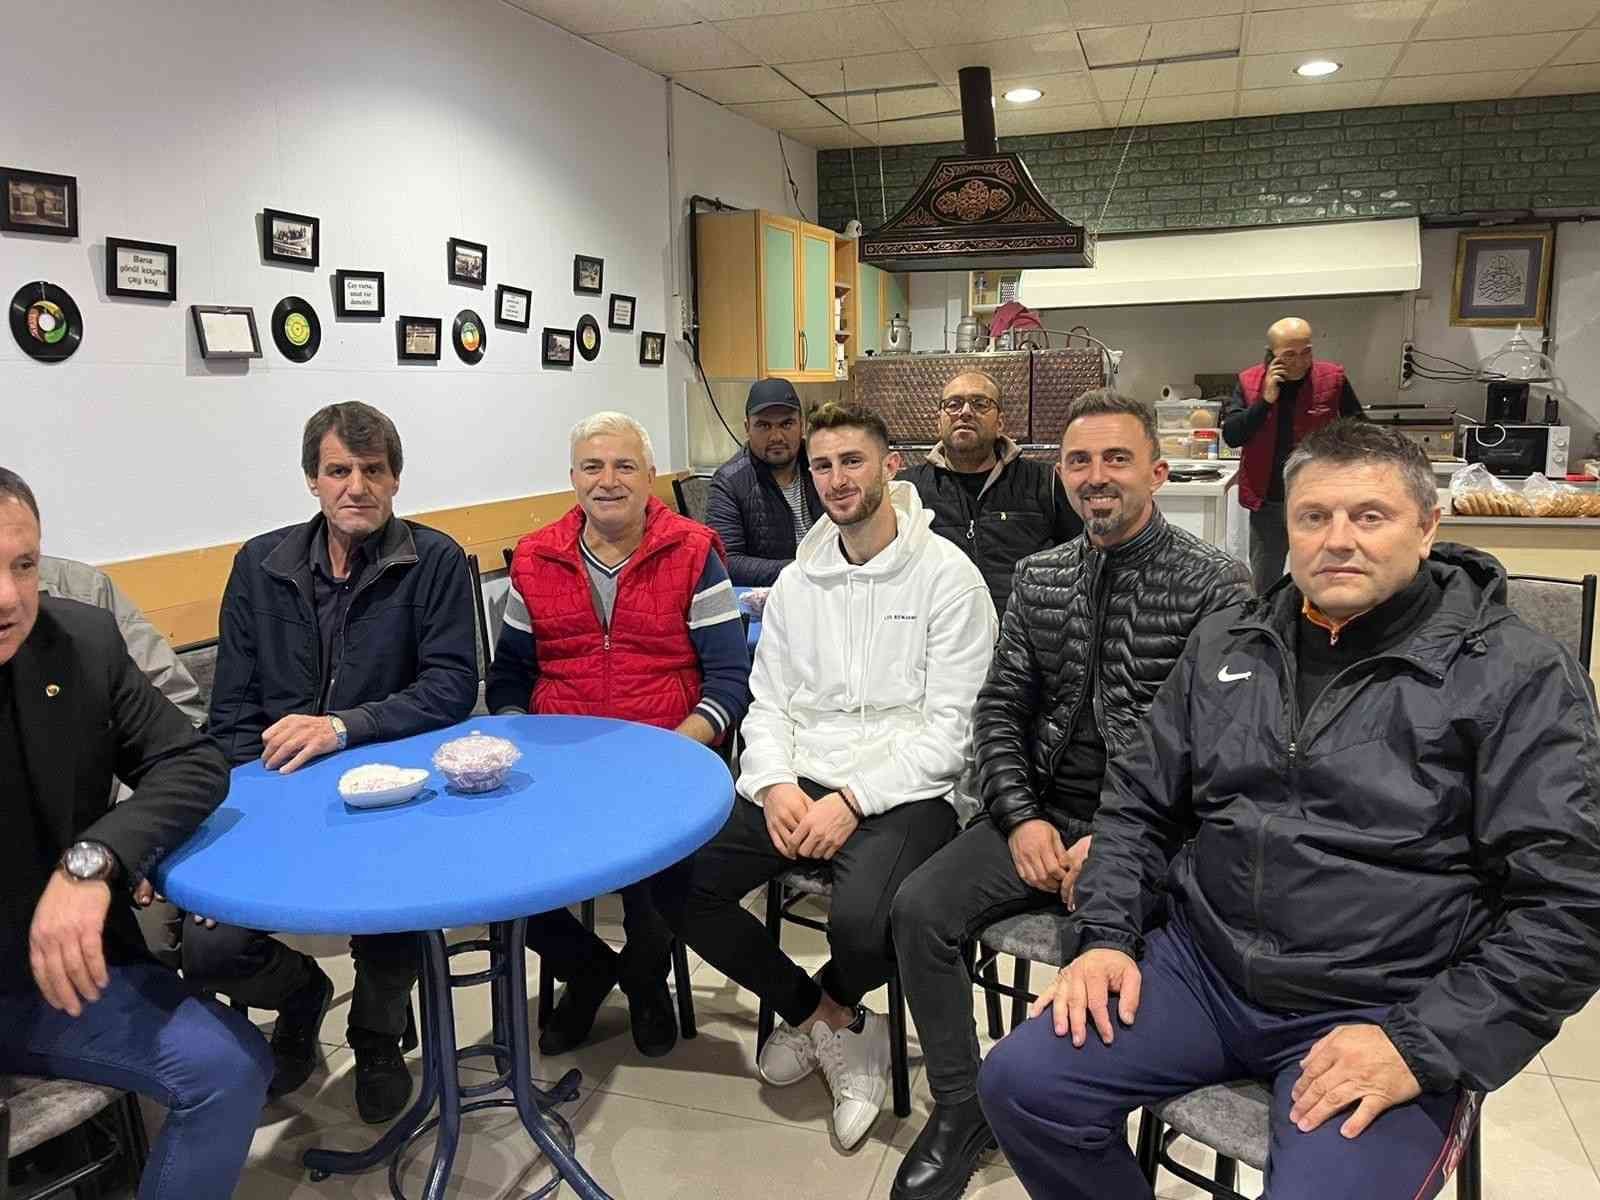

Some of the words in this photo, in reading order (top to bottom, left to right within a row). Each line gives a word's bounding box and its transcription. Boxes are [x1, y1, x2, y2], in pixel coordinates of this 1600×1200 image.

[133, 255, 152, 264] Bana
[142, 266, 167, 276] koyma
[144, 276, 158, 287] koy
